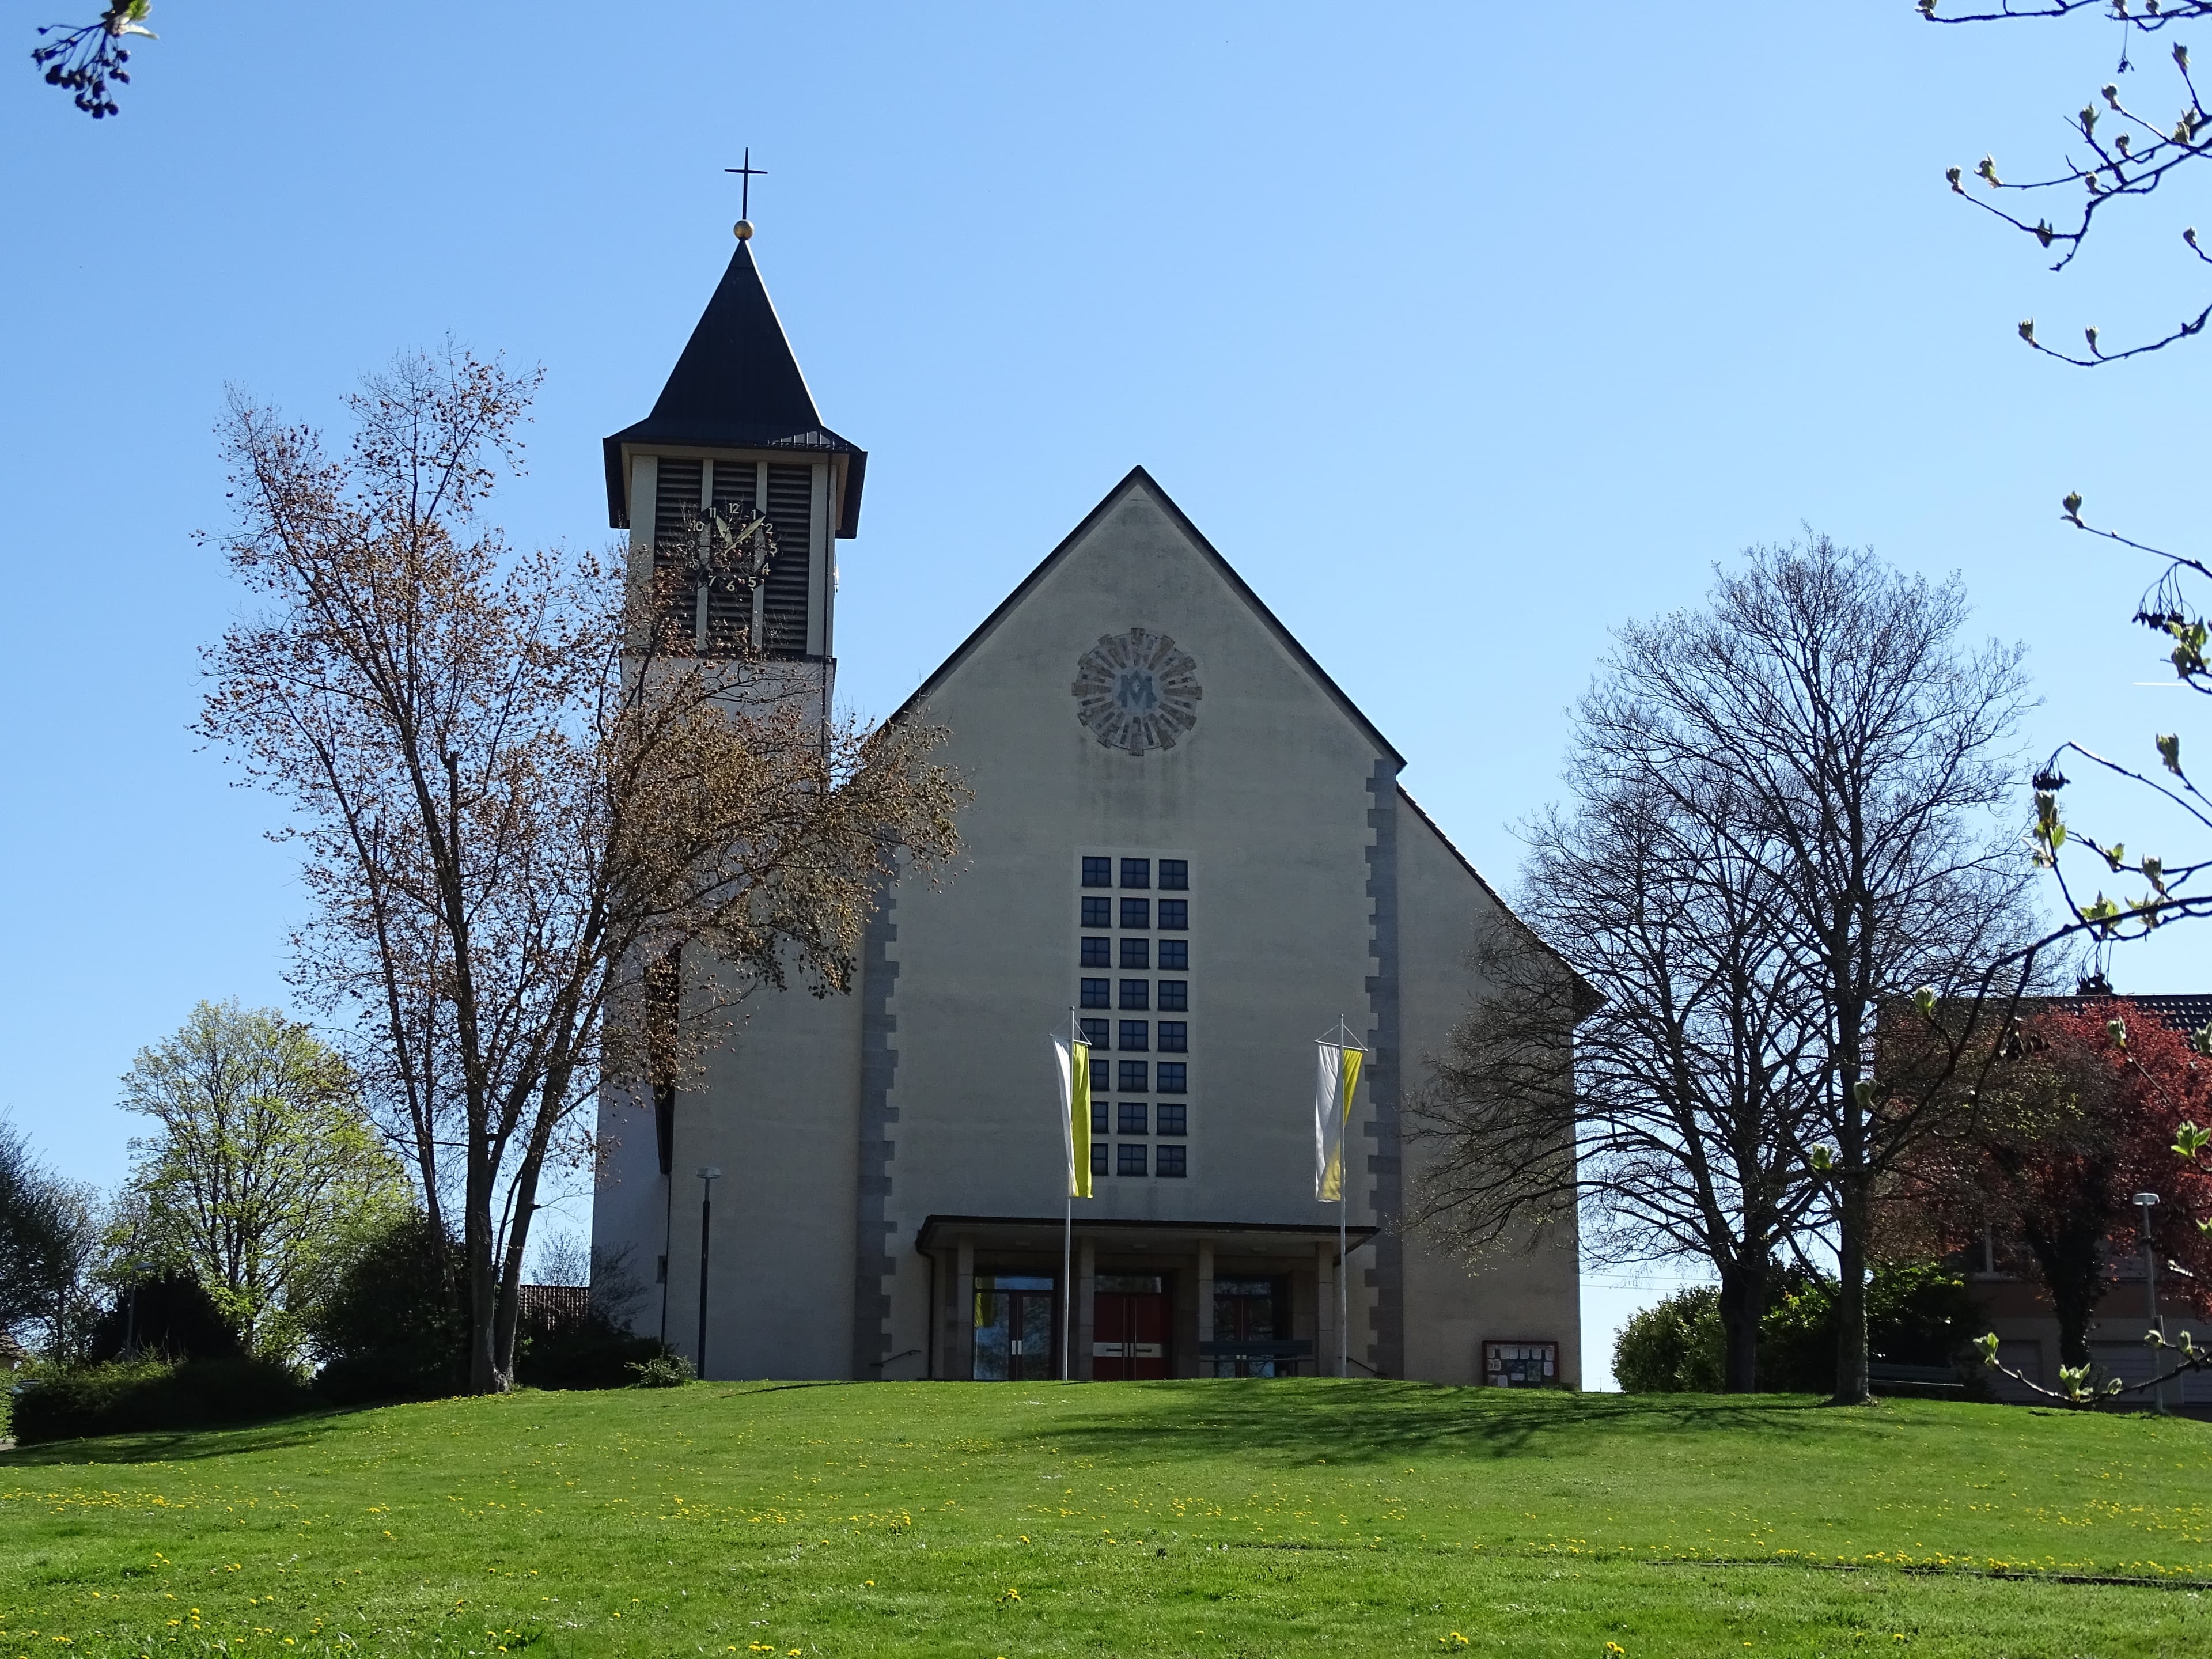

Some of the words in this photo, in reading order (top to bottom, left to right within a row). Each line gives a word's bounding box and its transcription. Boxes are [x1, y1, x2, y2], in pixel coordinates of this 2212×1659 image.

[708, 507, 717, 518] 11
[728, 503, 740, 514] 12
[751, 509, 756, 520] 1
[692, 520, 704, 532] 10
[765, 523, 774, 534] 2
[762, 562, 771, 574] 4
[708, 575, 717, 586] 7
[727, 580, 735, 592] 6
[748, 577, 757, 588] 5
